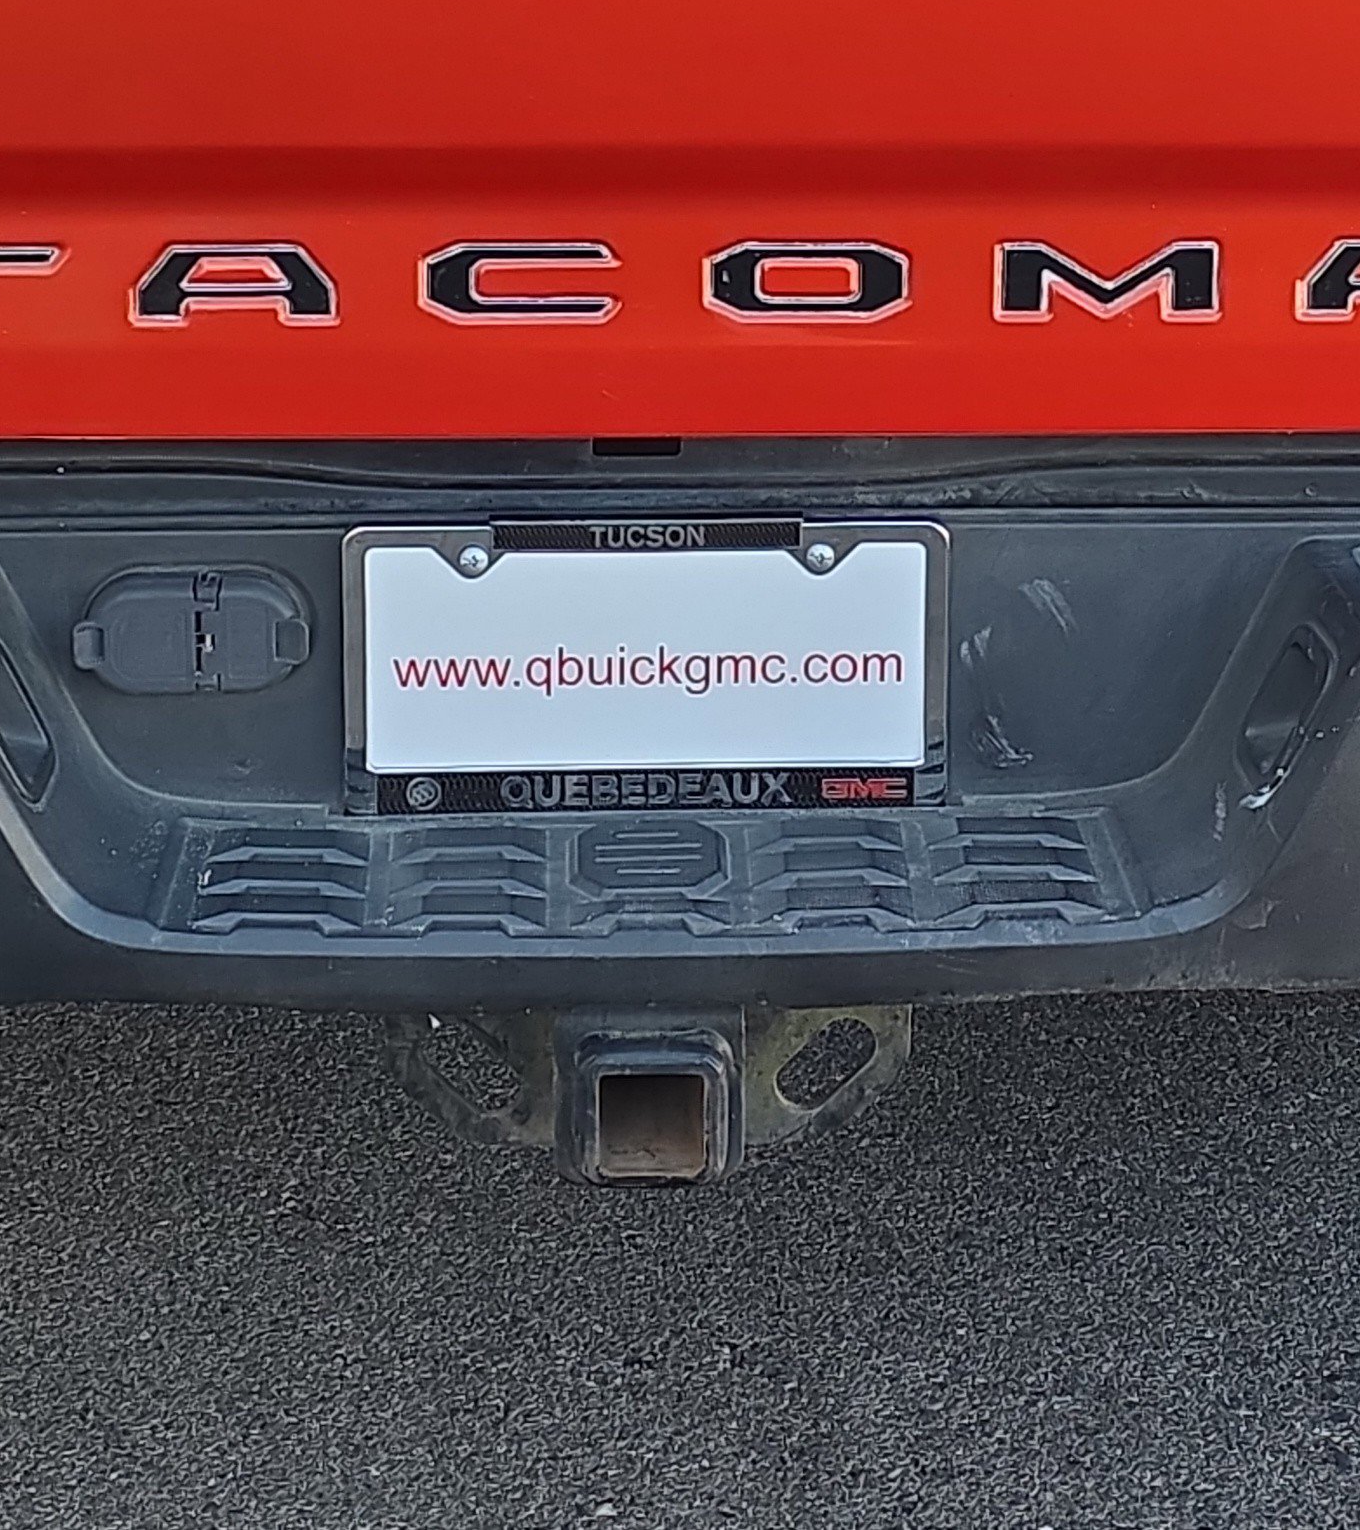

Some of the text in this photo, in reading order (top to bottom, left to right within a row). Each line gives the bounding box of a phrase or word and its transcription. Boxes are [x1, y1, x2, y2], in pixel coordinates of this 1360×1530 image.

[590, 525, 707, 549] TUCSON
[392, 644, 904, 697] www.qbuickgmc.com
[499, 772, 909, 808] QUEBEDEAUX GMC
